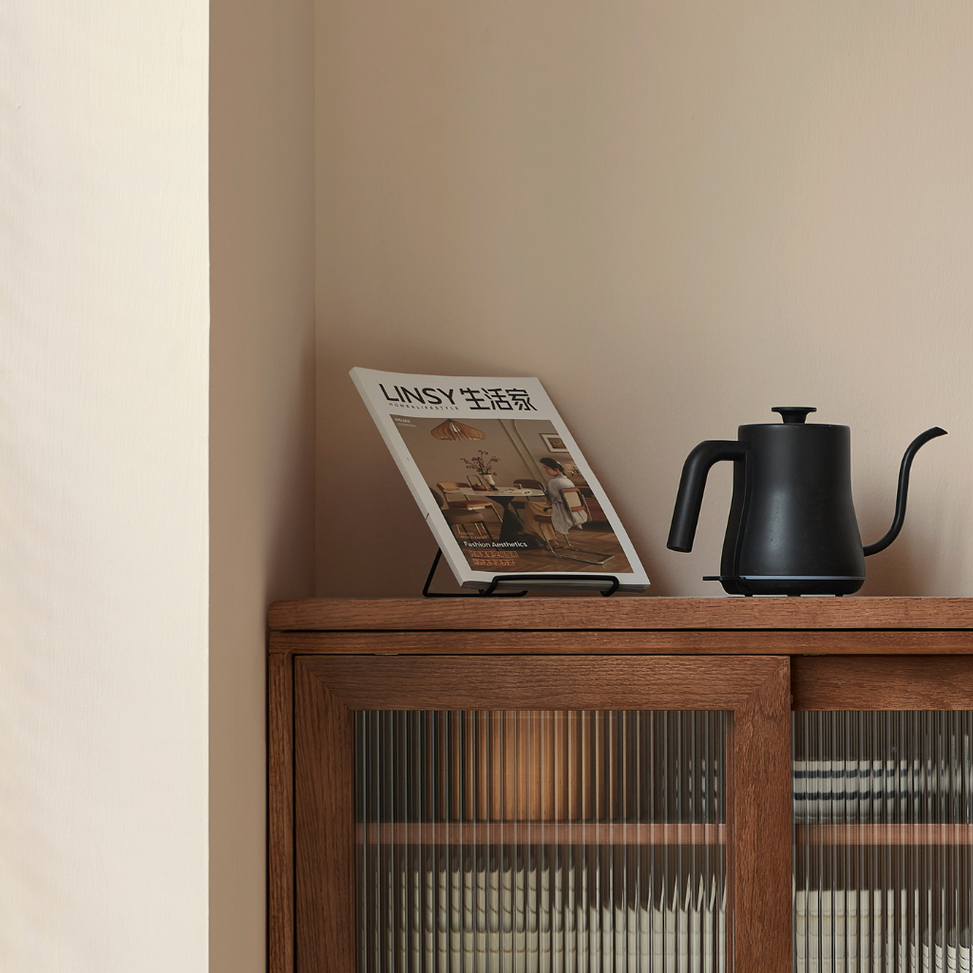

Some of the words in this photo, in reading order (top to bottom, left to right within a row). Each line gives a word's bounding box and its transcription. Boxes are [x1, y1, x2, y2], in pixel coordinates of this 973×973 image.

[379, 383, 456, 405] LINSY
[459, 387, 538, 411] 生活家
